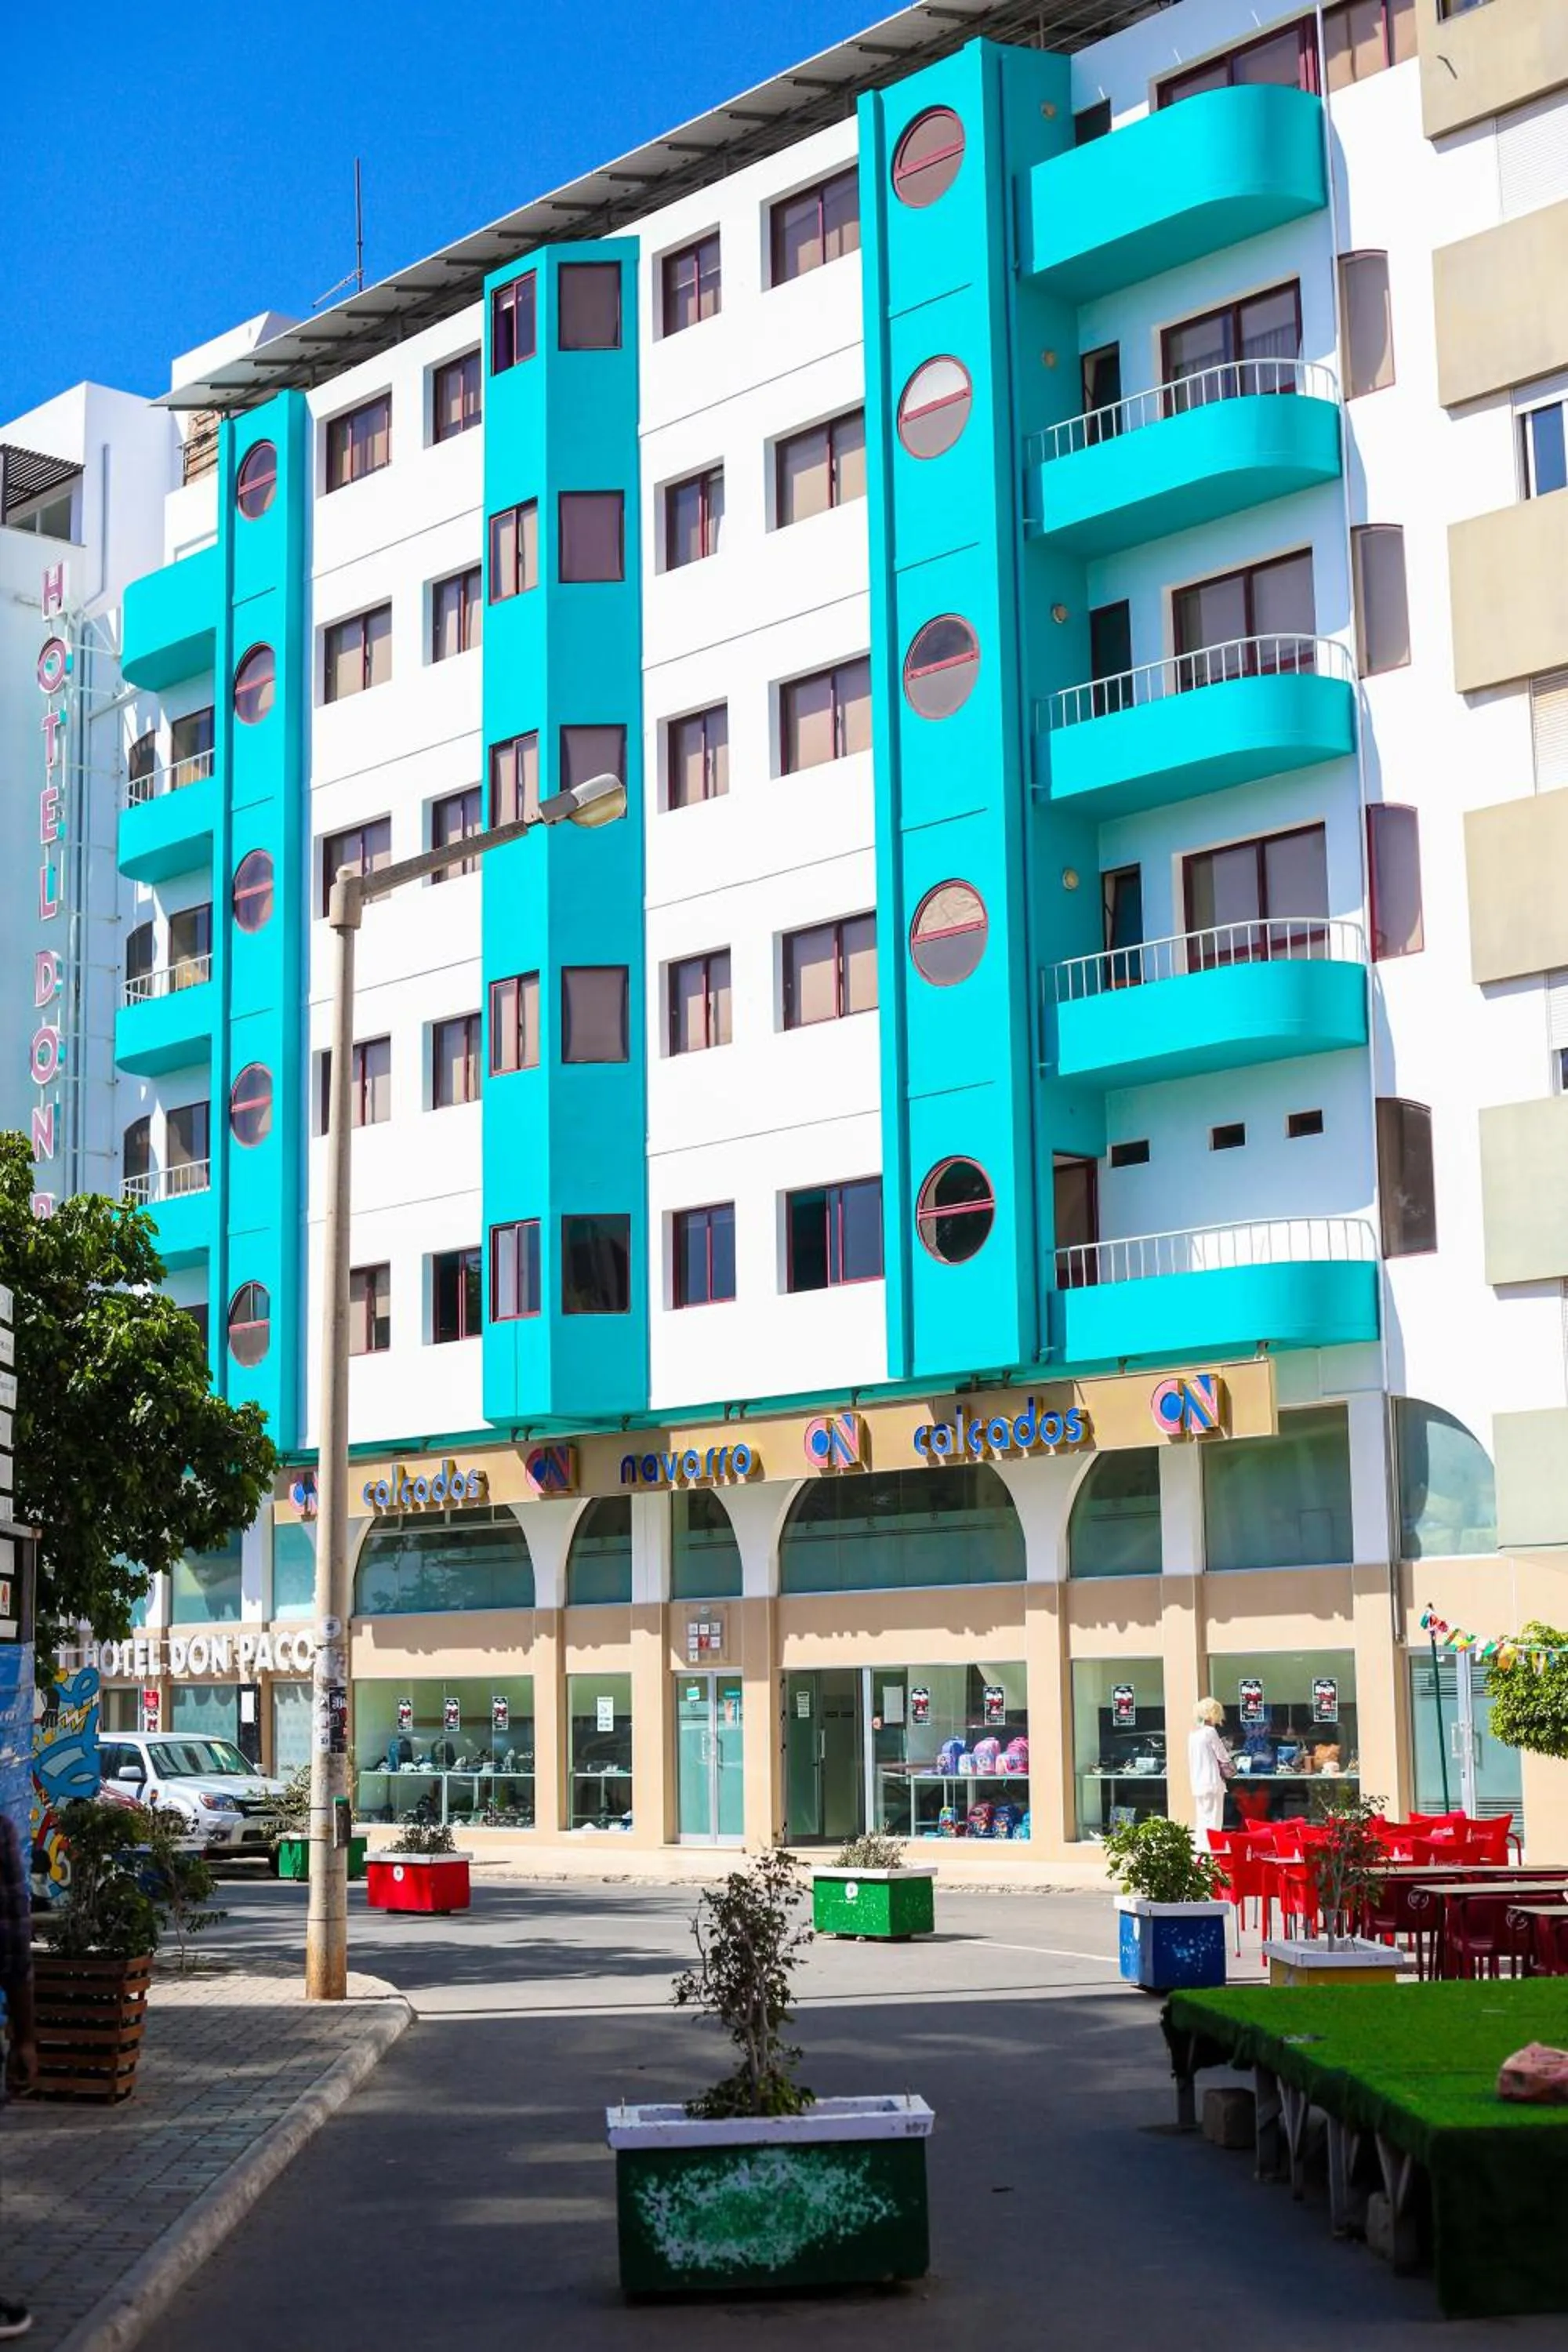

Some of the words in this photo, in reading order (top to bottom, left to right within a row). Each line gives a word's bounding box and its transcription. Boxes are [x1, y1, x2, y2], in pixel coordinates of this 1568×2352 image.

[38, 561, 68, 921] HOTEL
[31, 949, 59, 1160] DON
[620, 1443, 752, 1484] navarro
[913, 1396, 1083, 1455] calçados
[169, 1635, 230, 1675] DON
[239, 1629, 315, 1671] PACO
